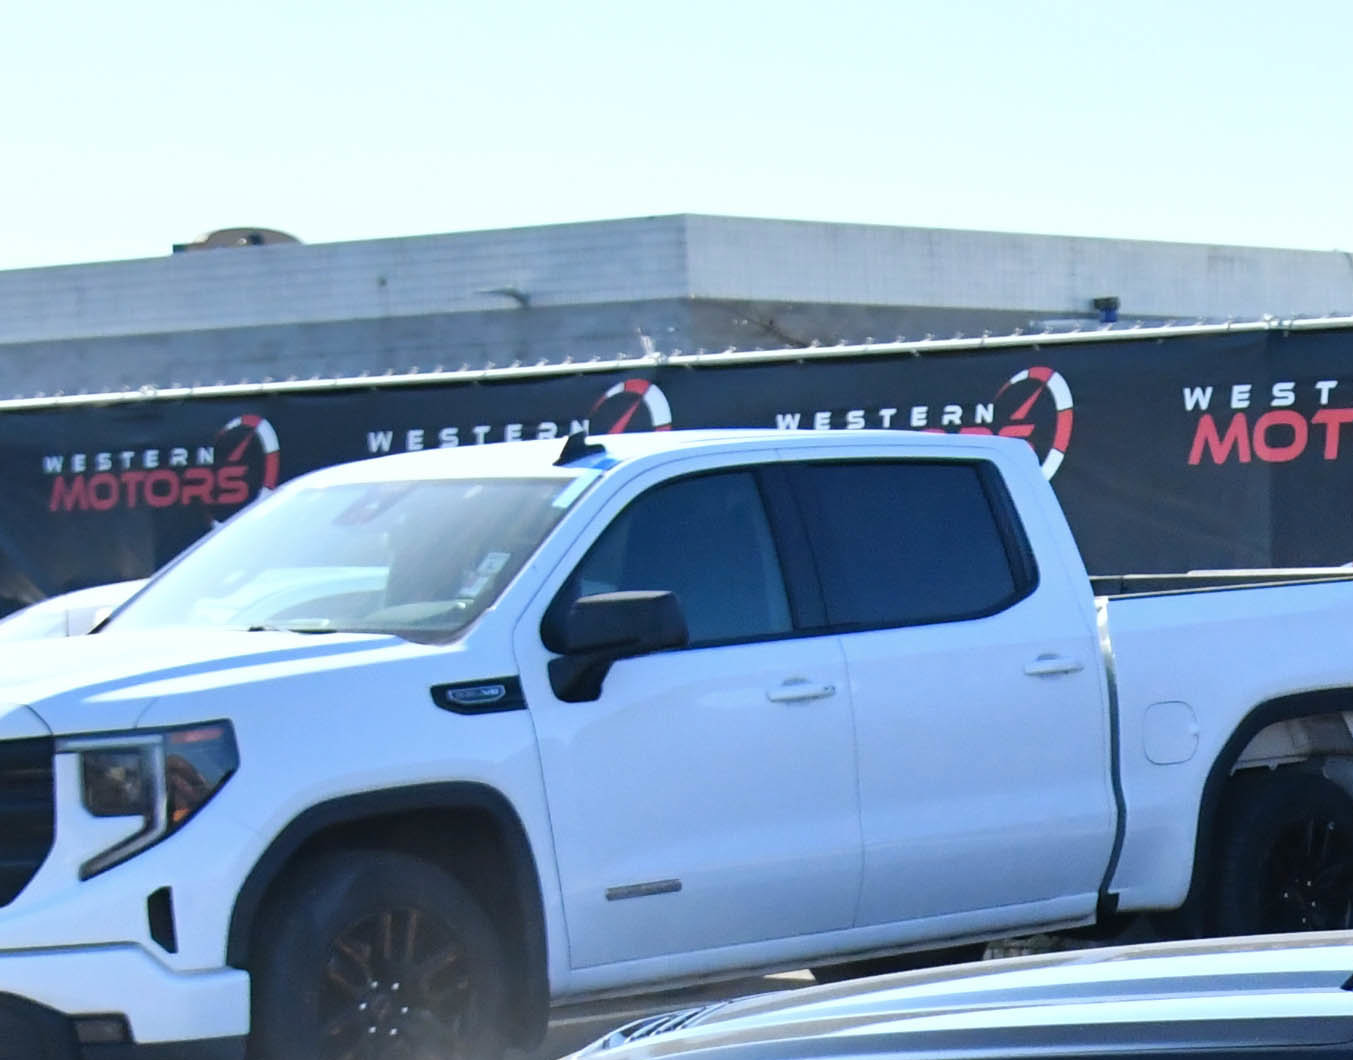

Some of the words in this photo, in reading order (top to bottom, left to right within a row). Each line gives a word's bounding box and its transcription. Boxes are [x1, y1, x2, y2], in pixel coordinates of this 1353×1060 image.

[776, 403, 994, 430] WESTERN
[43, 446, 214, 473] WESTERN
[49, 465, 249, 512] MOTORS
